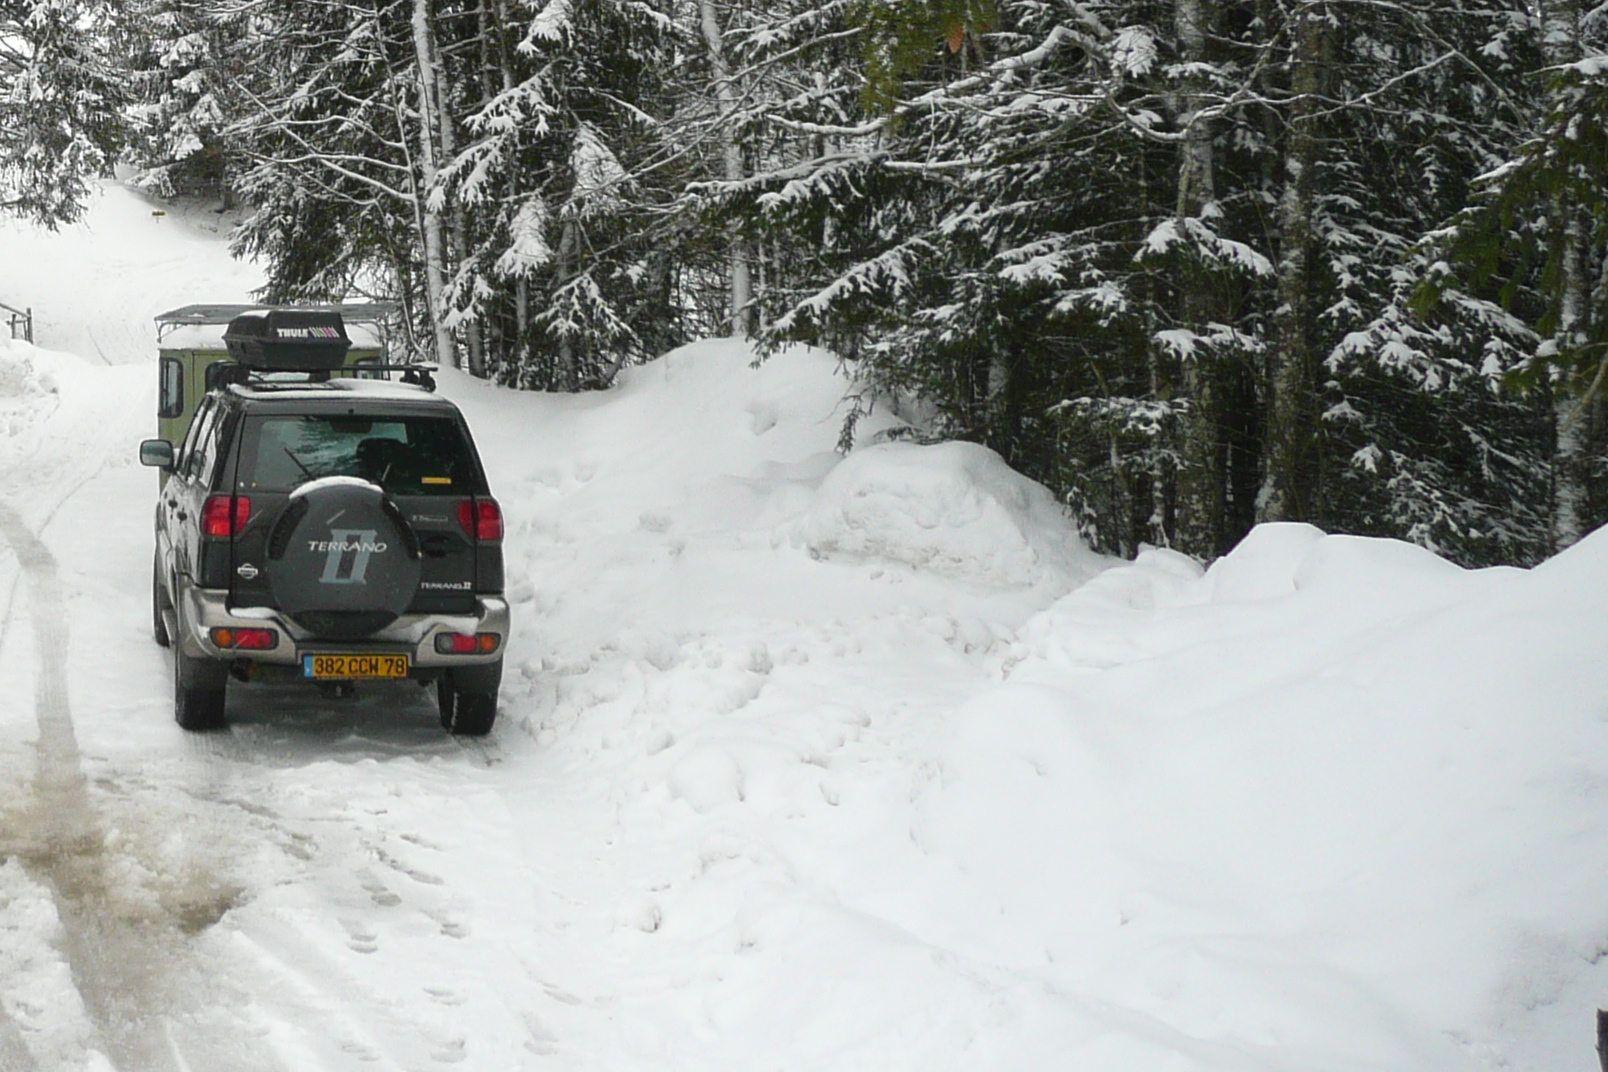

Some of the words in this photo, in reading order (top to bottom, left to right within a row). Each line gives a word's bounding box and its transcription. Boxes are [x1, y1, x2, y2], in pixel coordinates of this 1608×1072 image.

[277, 328, 309, 338] THULE
[308, 540, 388, 553] TERRANO
[314, 657, 345, 675] 382
[348, 657, 379, 675] CCW
[384, 657, 405, 675] 78
